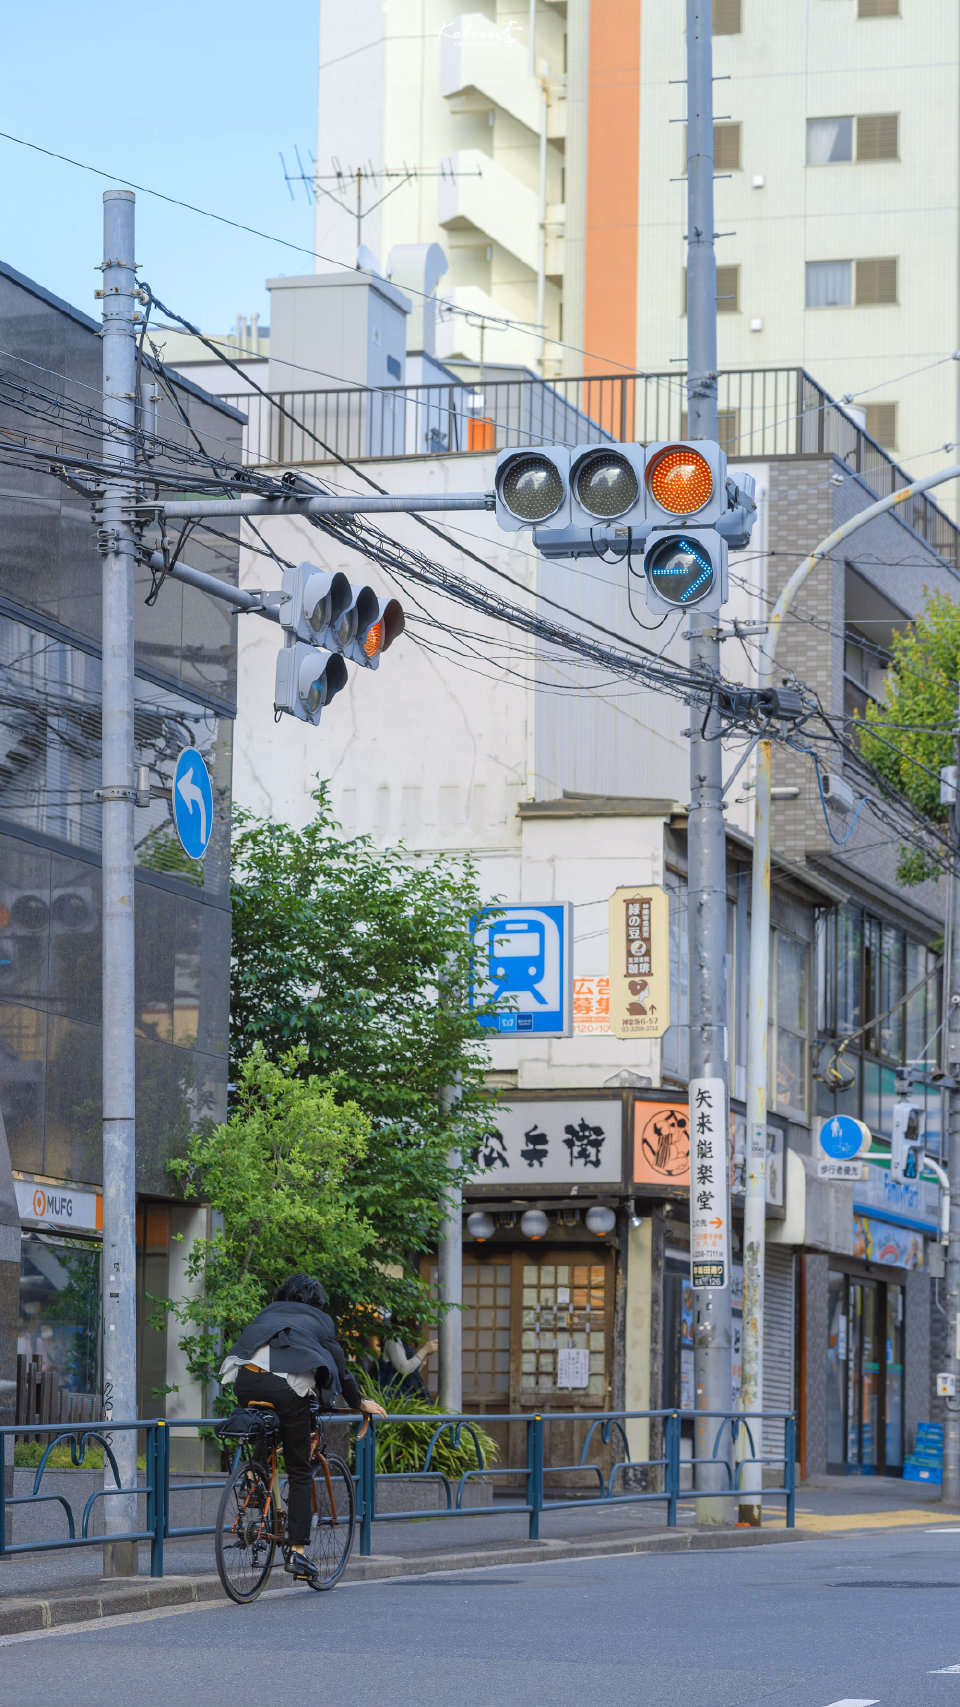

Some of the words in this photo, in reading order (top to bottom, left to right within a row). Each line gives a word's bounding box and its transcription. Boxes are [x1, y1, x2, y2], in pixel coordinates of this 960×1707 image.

[695, 1087, 714, 1212] 矢来能楽堂
[47, 1194, 73, 1217] MUFG
